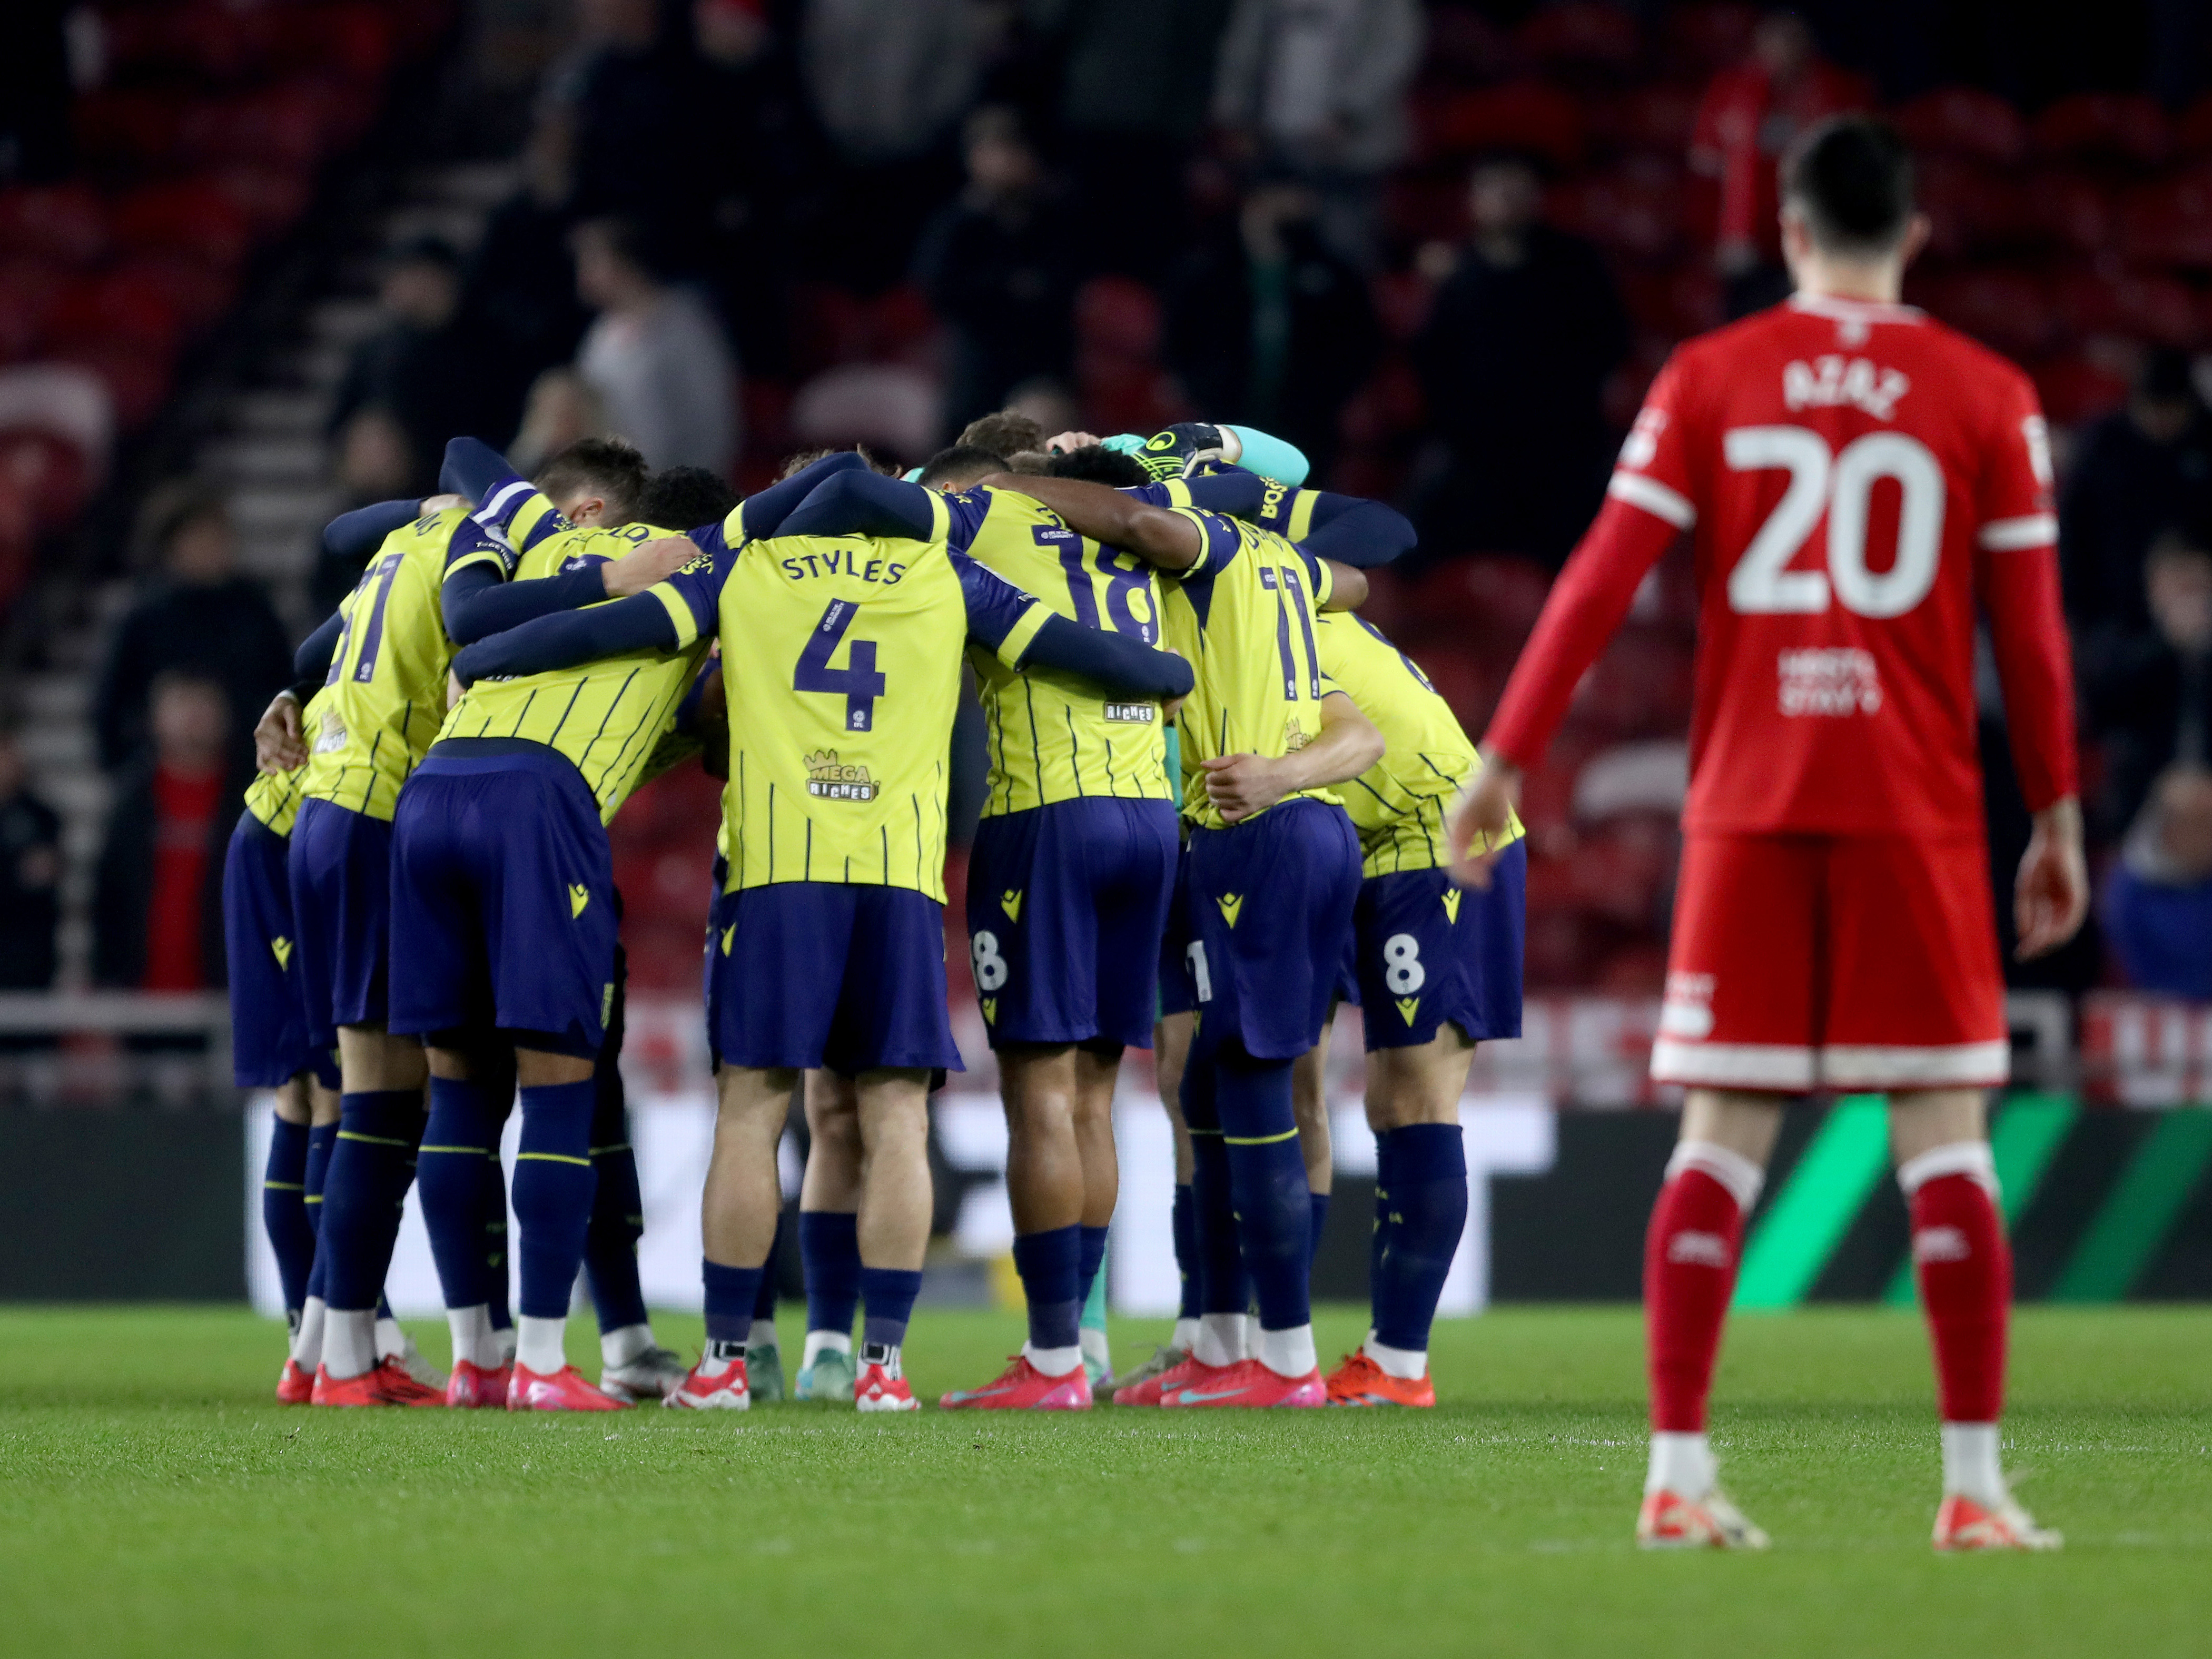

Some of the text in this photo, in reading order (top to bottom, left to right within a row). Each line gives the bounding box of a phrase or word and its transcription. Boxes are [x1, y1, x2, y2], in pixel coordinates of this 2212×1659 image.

[1783, 355, 1910, 421] AZAZ
[1723, 423, 1946, 618] 20
[782, 550, 905, 585] STYLES
[1031, 525, 1158, 646] 18
[1258, 566, 1320, 700] 11
[793, 598, 885, 732] 4
[1107, 705, 1152, 721] RICHES
[809, 783, 871, 799] RICHES
[810, 765, 871, 783] MEGA
[1384, 933, 1426, 994] 8
